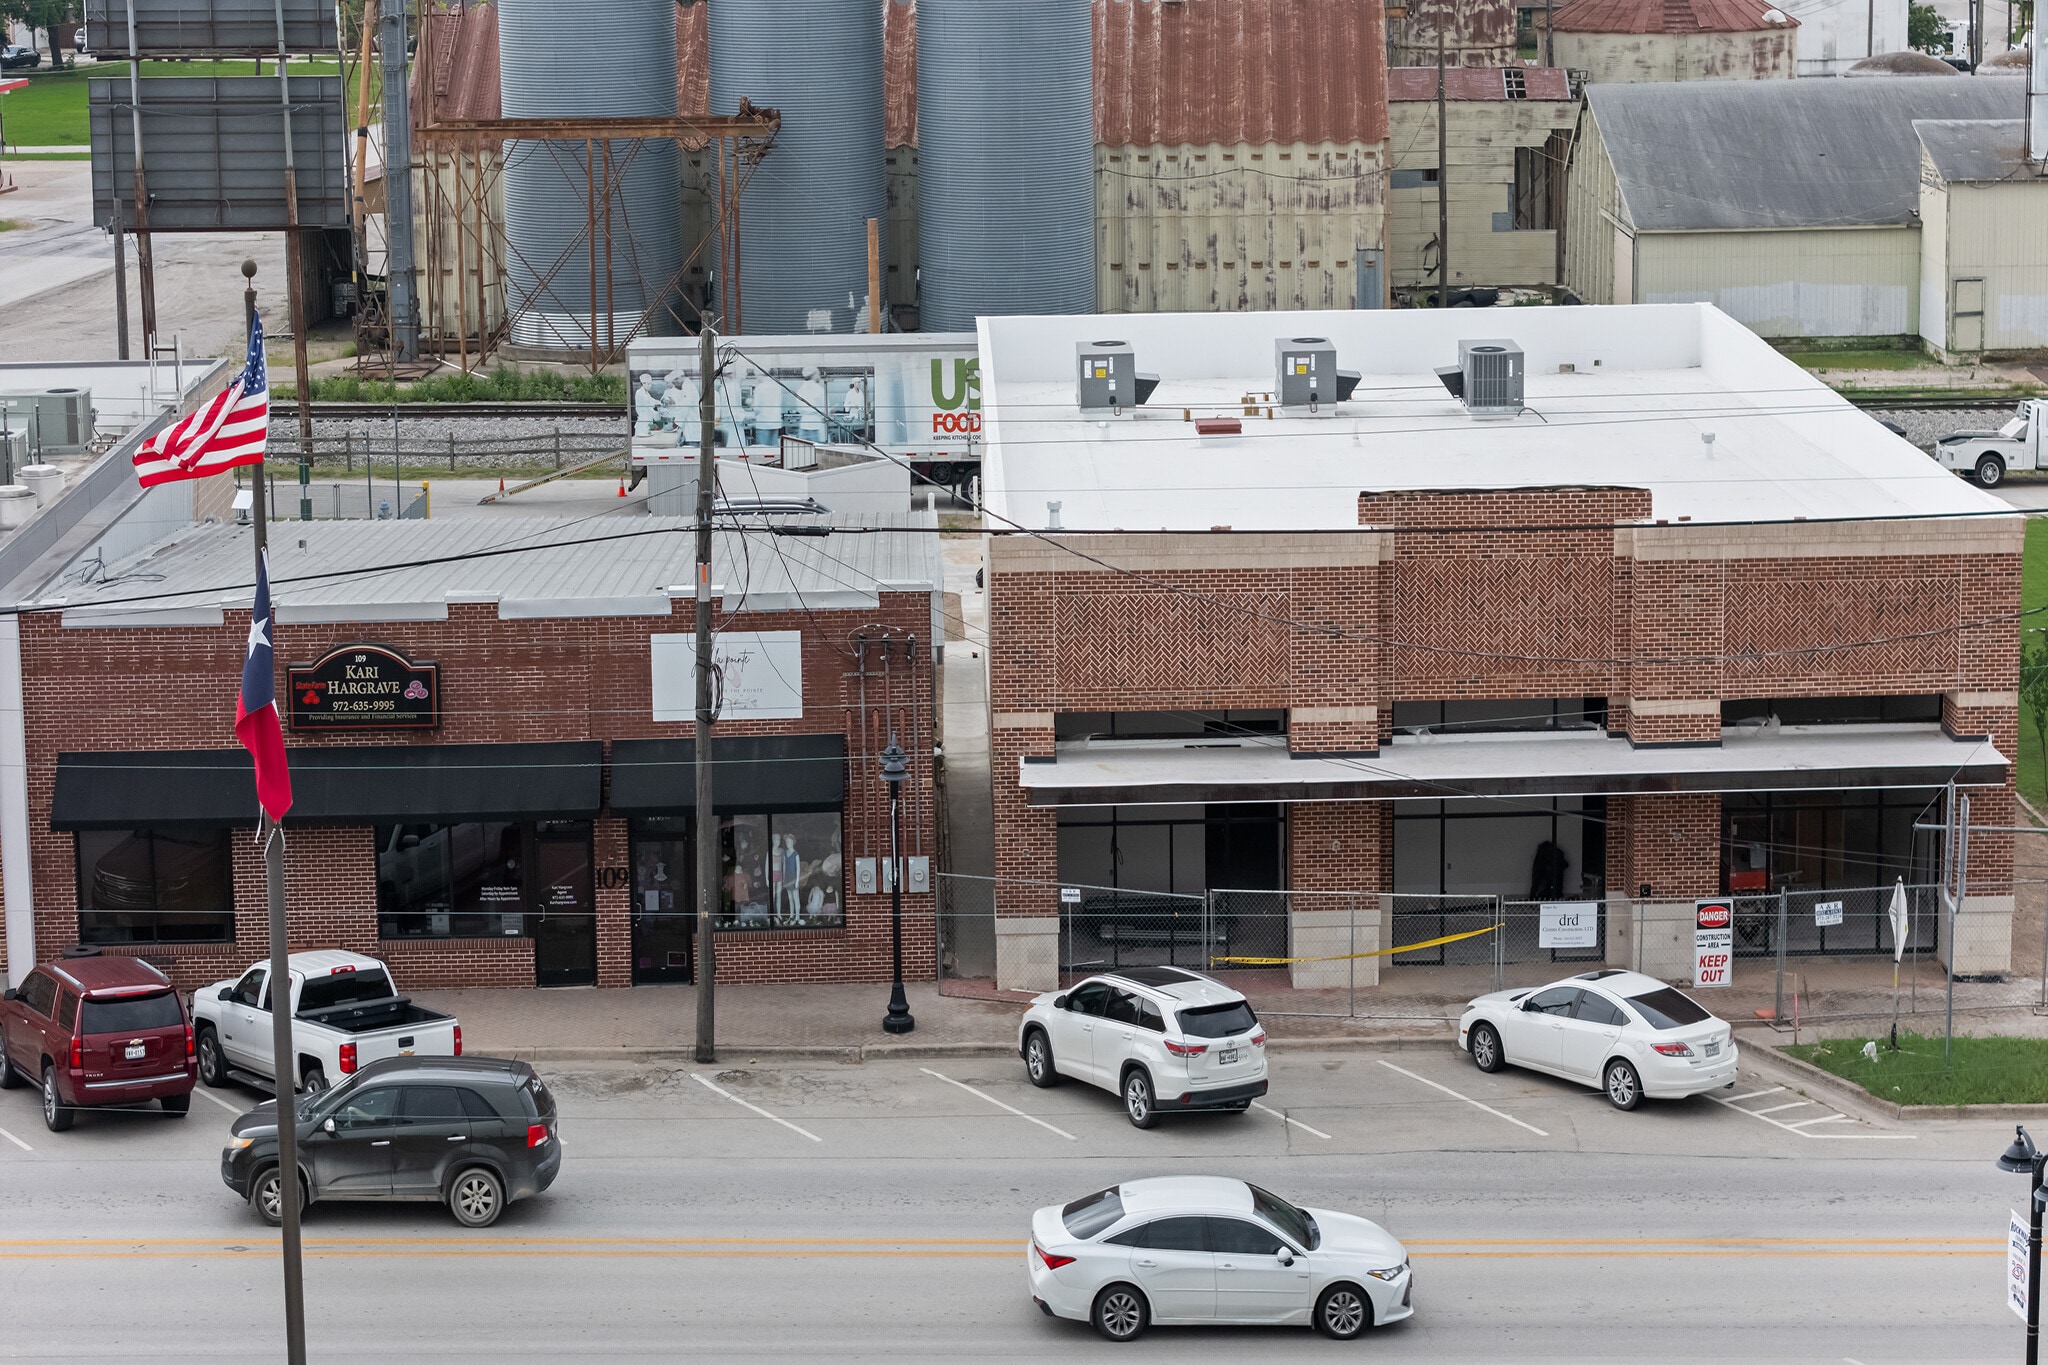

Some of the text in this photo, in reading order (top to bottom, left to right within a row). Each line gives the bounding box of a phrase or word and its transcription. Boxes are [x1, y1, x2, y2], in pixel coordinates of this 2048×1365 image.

[355, 655, 367, 663] 109
[345, 665, 379, 679] KARI
[327, 680, 400, 695] HARGRAVE
[332, 700, 395, 711] 972-635-9995
[596, 867, 629, 889] 109
[1559, 912, 1579, 927] drd
[1699, 911, 1729, 922] DANGER
[1696, 933, 1731, 942] CONSTRUCTION
[1699, 954, 1729, 968] KEEP
[1700, 969, 1725, 983] OUT
